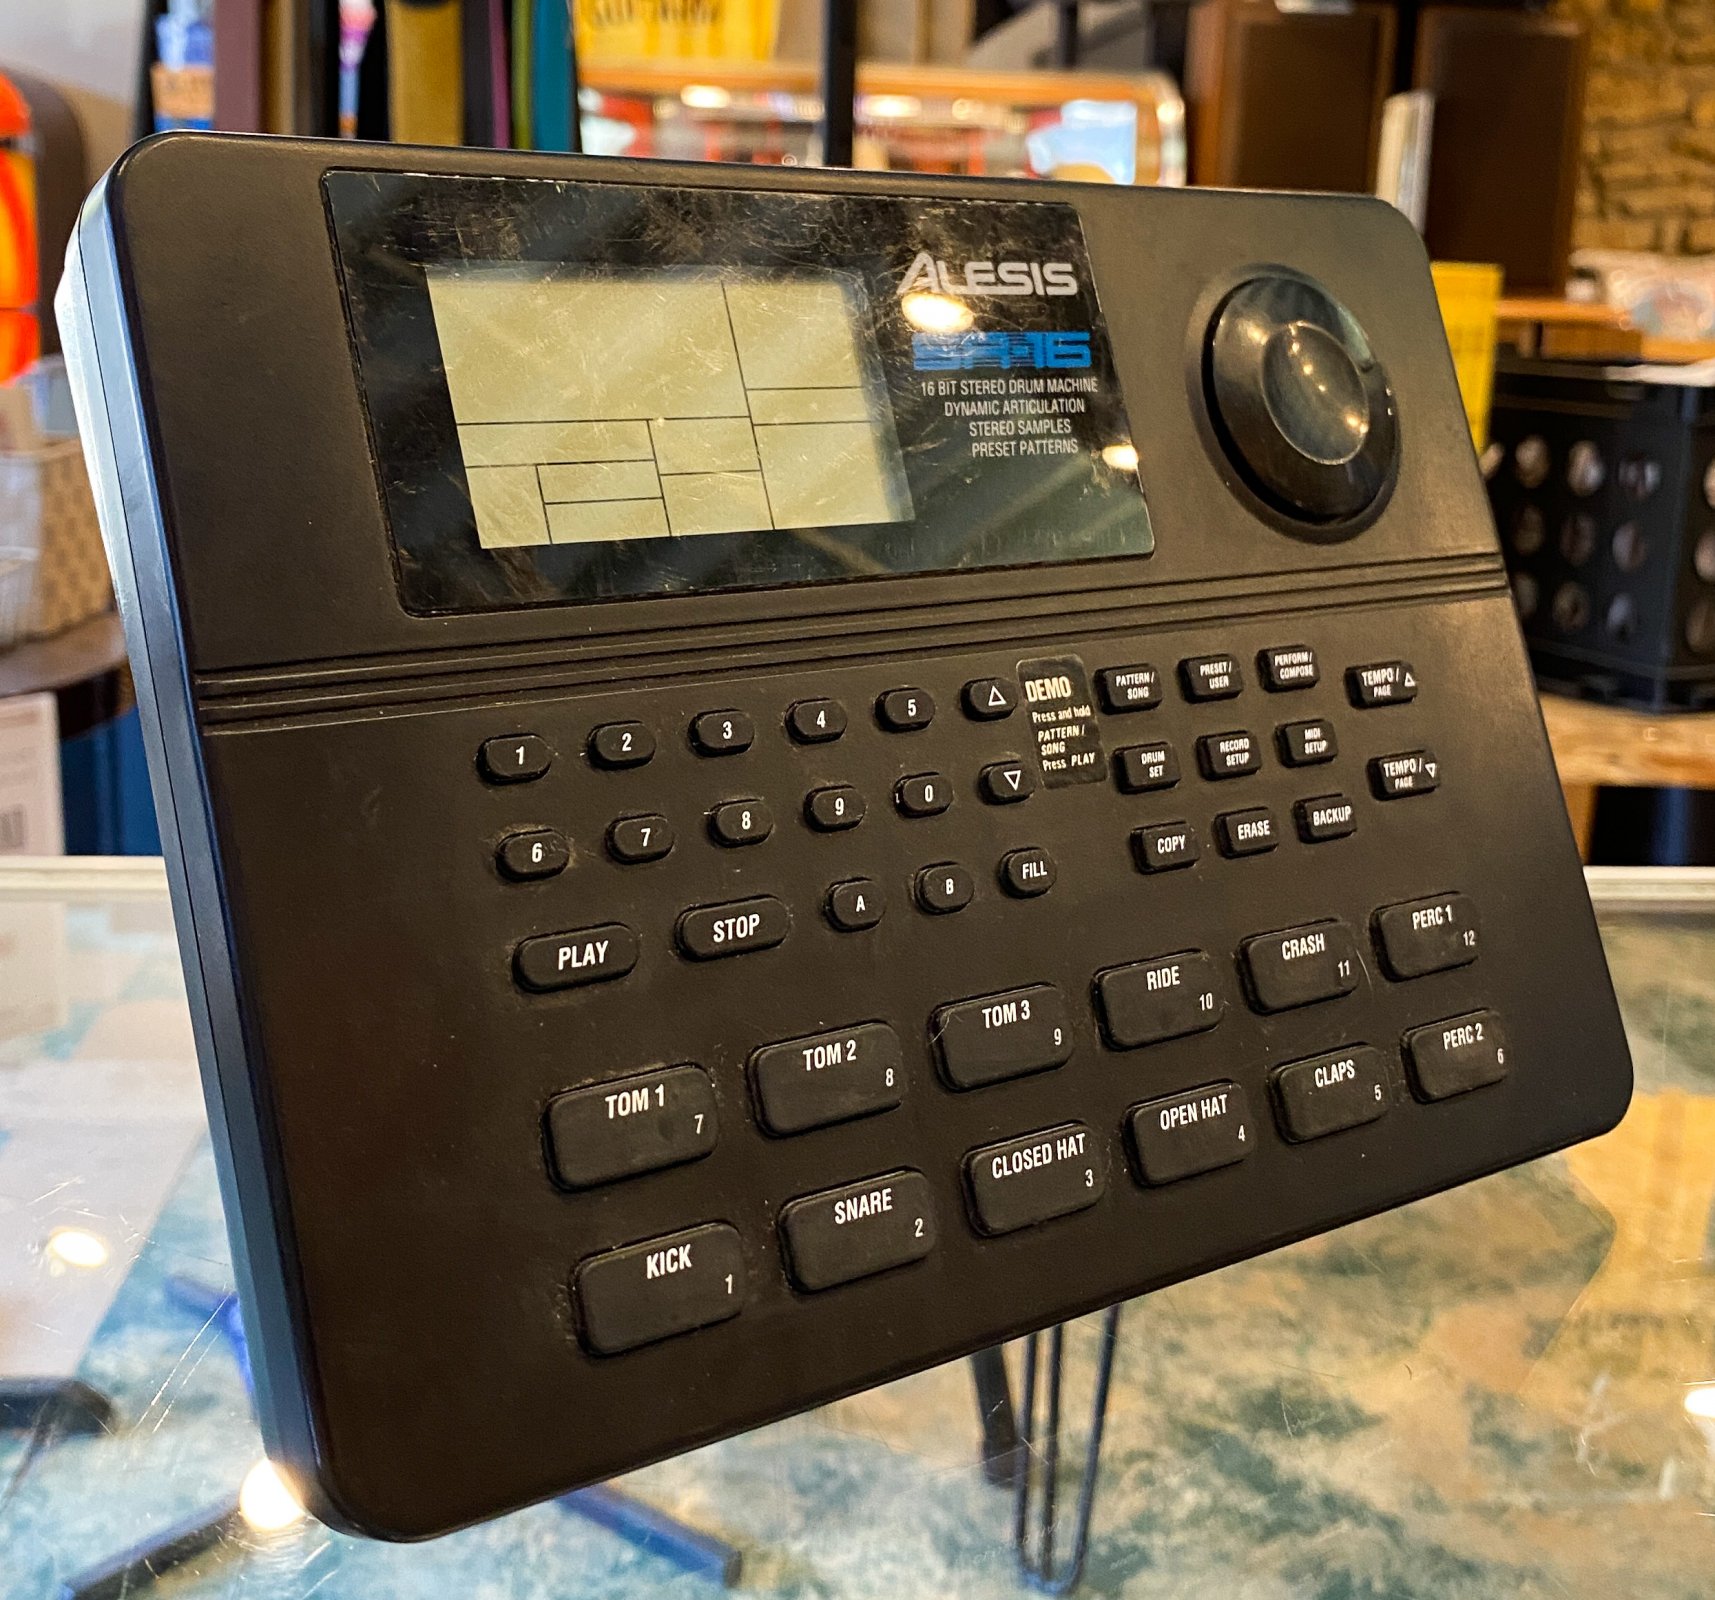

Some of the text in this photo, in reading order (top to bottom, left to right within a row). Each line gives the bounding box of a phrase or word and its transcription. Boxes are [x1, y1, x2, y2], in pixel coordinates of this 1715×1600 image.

[897, 252, 1078, 296] ALESIS
[921, 377, 1098, 397] 16 BIT STEREO DRUM MACHINE
[944, 398, 1085, 417] DYNAMIC ARTICULATION
[969, 418, 1072, 437] STEREO SAMPLES
[972, 438, 1079, 458] PRESET PATTERNS
[1279, 664, 1314, 680] COMPOSE
[1025, 676, 1072, 702] DEMO
[1209, 676, 1229, 690] USER
[1373, 683, 1392, 697] PAGE
[1127, 686, 1149, 700] SONG
[907, 698, 917, 717] 5
[1032, 705, 1092, 723] Press and hold
[816, 710, 826, 728] 4
[722, 721, 733, 740] 3
[1304, 728, 1322, 740] MIDI
[621, 733, 632, 752] 2
[1041, 741, 1066, 756] SONG
[1220, 738, 1250, 753] RECORD
[1304, 740, 1328, 755] SETUP
[515, 746, 525, 765] 1
[1042, 752, 1095, 771] Press PLAY
[1141, 750, 1165, 765] DRUM
[1226, 753, 1250, 767] SETUP
[1149, 765, 1164, 778] SET
[1394, 775, 1414, 789] PAGE
[834, 798, 845, 816] 9
[1313, 805, 1352, 826] BACKUP
[742, 811, 751, 830] 8
[1237, 820, 1271, 840] ERASE
[640, 828, 651, 847] 7
[1157, 834, 1186, 854] COPY
[531, 843, 543, 863] 6
[1022, 860, 1047, 880] FILL
[946, 878, 954, 894] B
[856, 895, 866, 912] A
[1412, 904, 1453, 930] PERC 1
[713, 913, 760, 943] STOP
[1281, 932, 1326, 961] CRASH
[1463, 930, 1476, 947] 12
[558, 940, 609, 970] PLAY
[1146, 966, 1181, 991] RIDE
[1338, 960, 1350, 978] 11
[1199, 993, 1214, 1011] 10
[982, 1000, 1031, 1029] TOM 3
[1053, 1028, 1062, 1046] 9
[1442, 1022, 1484, 1050] PERC 2
[803, 1039, 857, 1071] TOM 2
[1497, 1048, 1504, 1065] 6
[885, 1068, 894, 1088] 8
[1314, 1058, 1356, 1088] CLAPS
[605, 1084, 665, 1119] TOM 1
[1374, 1084, 1382, 1101] 5
[1160, 1094, 1228, 1131] OPEN HAT
[694, 1114, 704, 1135] 7
[1237, 1124, 1246, 1142] 4
[992, 1132, 1086, 1179] CLOSED HAT
[1084, 1168, 1094, 1188] 3
[834, 1188, 894, 1226] SNARE
[914, 1218, 924, 1239] 2
[646, 1244, 693, 1280] KICK
[724, 1274, 734, 1295] 1
